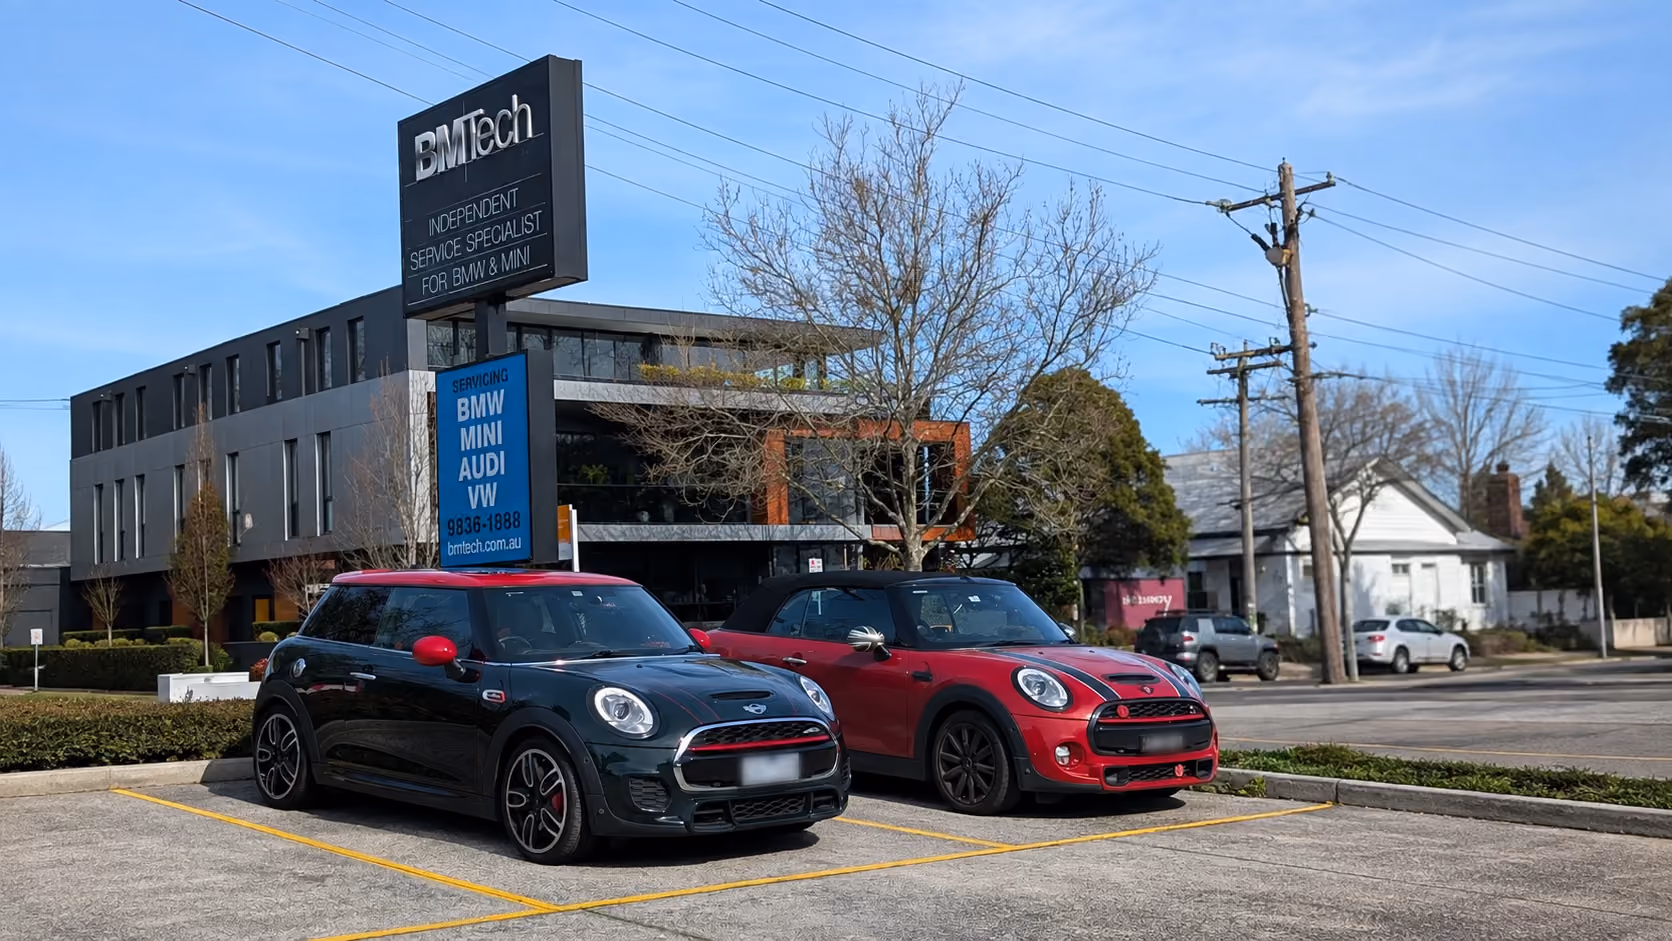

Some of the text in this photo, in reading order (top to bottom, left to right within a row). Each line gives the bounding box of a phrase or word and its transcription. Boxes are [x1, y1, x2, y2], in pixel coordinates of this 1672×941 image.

[415, 94, 533, 181] BMTech
[428, 188, 519, 237] INDEPENDENT
[410, 210, 542, 271] SERVICE SPECIALIST
[422, 245, 530, 295] FOR BMW & MINI
[452, 368, 509, 393] SERVICING
[457, 389, 505, 422] BMW
[460, 420, 503, 452] MINI
[458, 450, 505, 481] AUDI
[467, 482, 498, 509] VW
[447, 510, 521, 536] 9836-1888
[447, 537, 522, 556] bmtech.com.au
